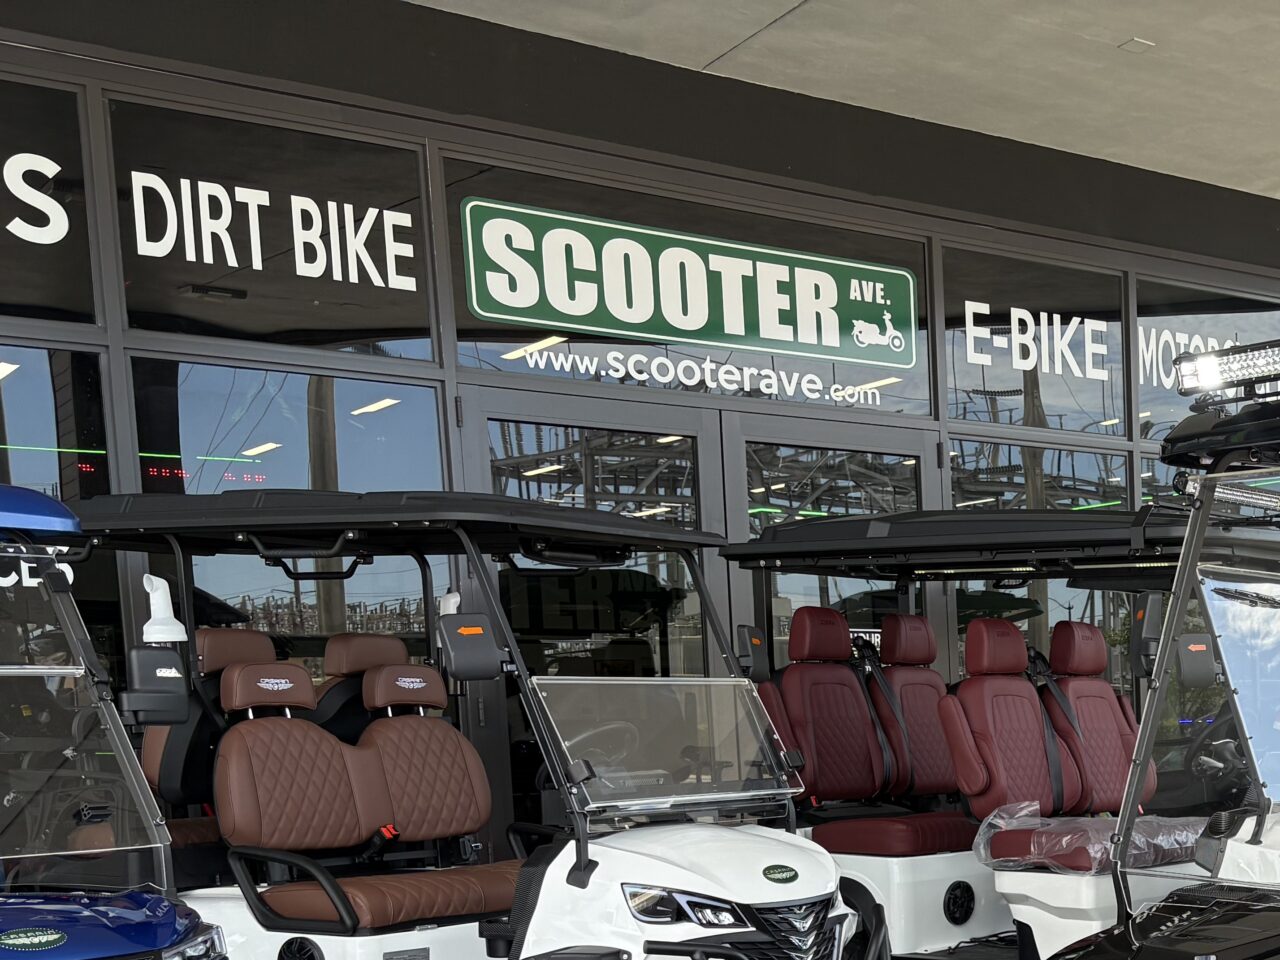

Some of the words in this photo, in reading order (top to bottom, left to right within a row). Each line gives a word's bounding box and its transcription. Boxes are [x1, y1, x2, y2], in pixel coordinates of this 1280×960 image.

[131, 171, 270, 270] DIRT
[291, 196, 417, 291] BIKE
[482, 218, 841, 347] SCOOTER
[850, 279, 891, 305] AVE.
[964, 300, 1109, 380] E-BIKE
